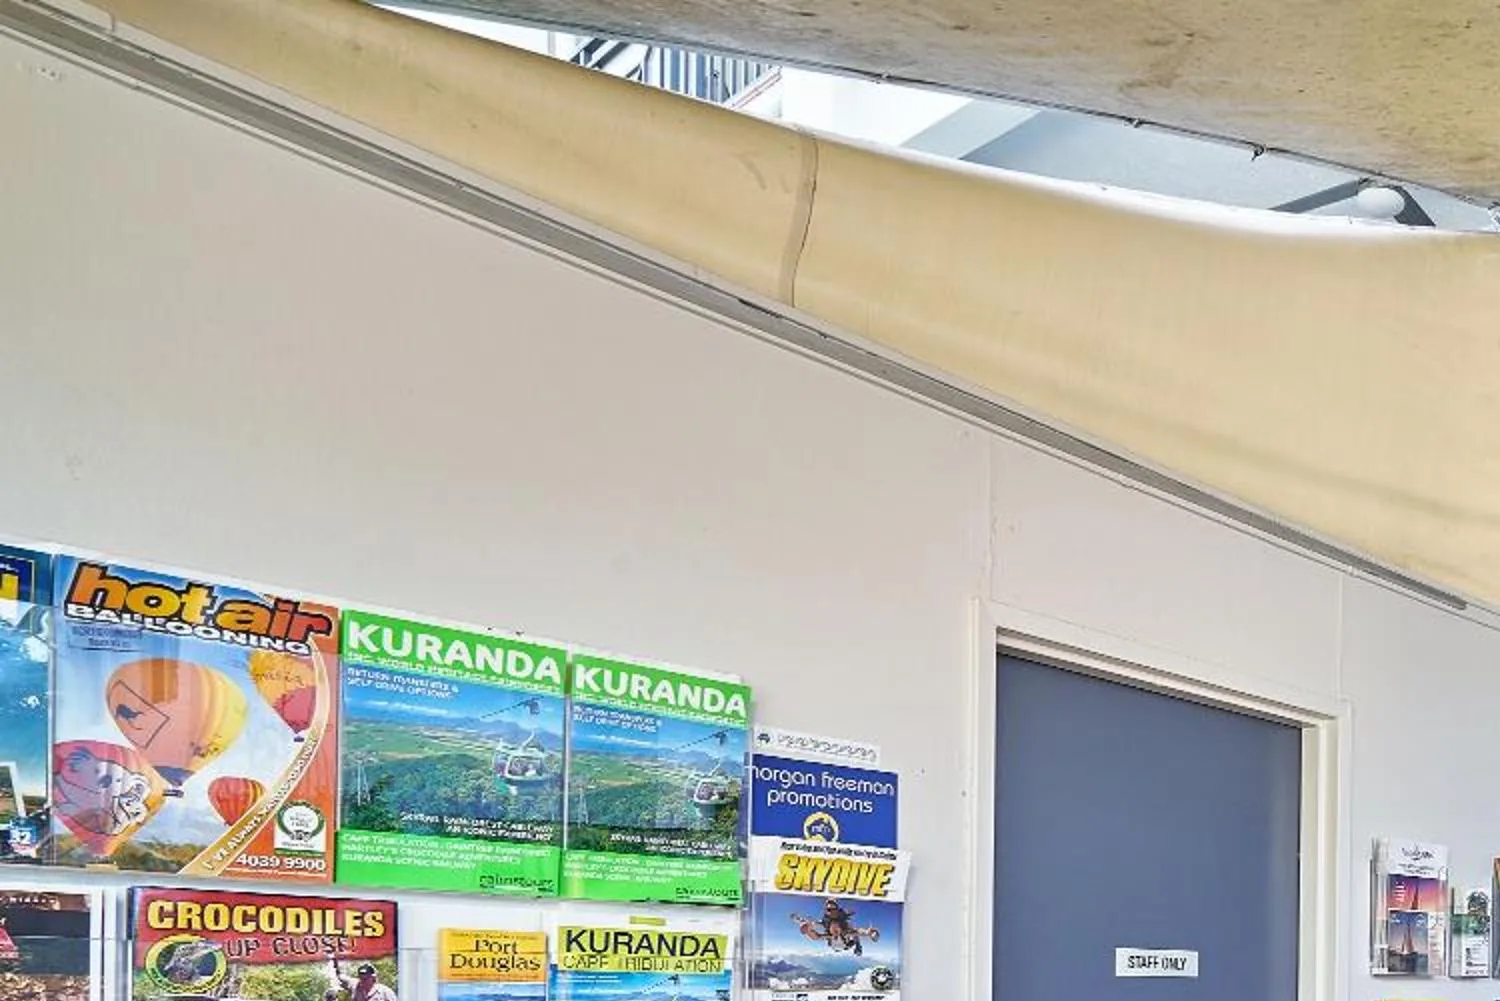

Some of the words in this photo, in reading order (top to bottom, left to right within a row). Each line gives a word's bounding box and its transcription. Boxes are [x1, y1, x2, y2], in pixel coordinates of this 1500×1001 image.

[66, 560, 216, 626] hot
[216, 593, 333, 643] air
[64, 605, 313, 657] BALLOONING
[348, 620, 561, 685] KURANDA
[575, 663, 747, 718] KURANDA
[821, 771, 895, 797] freeman
[767, 788, 874, 814] promotions
[236, 854, 280, 869] 4039
[284, 856, 327, 872] 9900
[774, 852, 896, 898] SKYDIVE
[146, 899, 386, 938] CROCODILES
[226, 940, 260, 959] UP
[474, 939, 518, 955] Port
[565, 929, 721, 959] KURANDA
[449, 953, 542, 973] Douglas
[562, 955, 609, 970] CAPE
[618, 955, 723, 973] TRIBULATION
[1127, 955, 1159, 969] STAFF
[1161, 957, 1187, 971] ONLY
